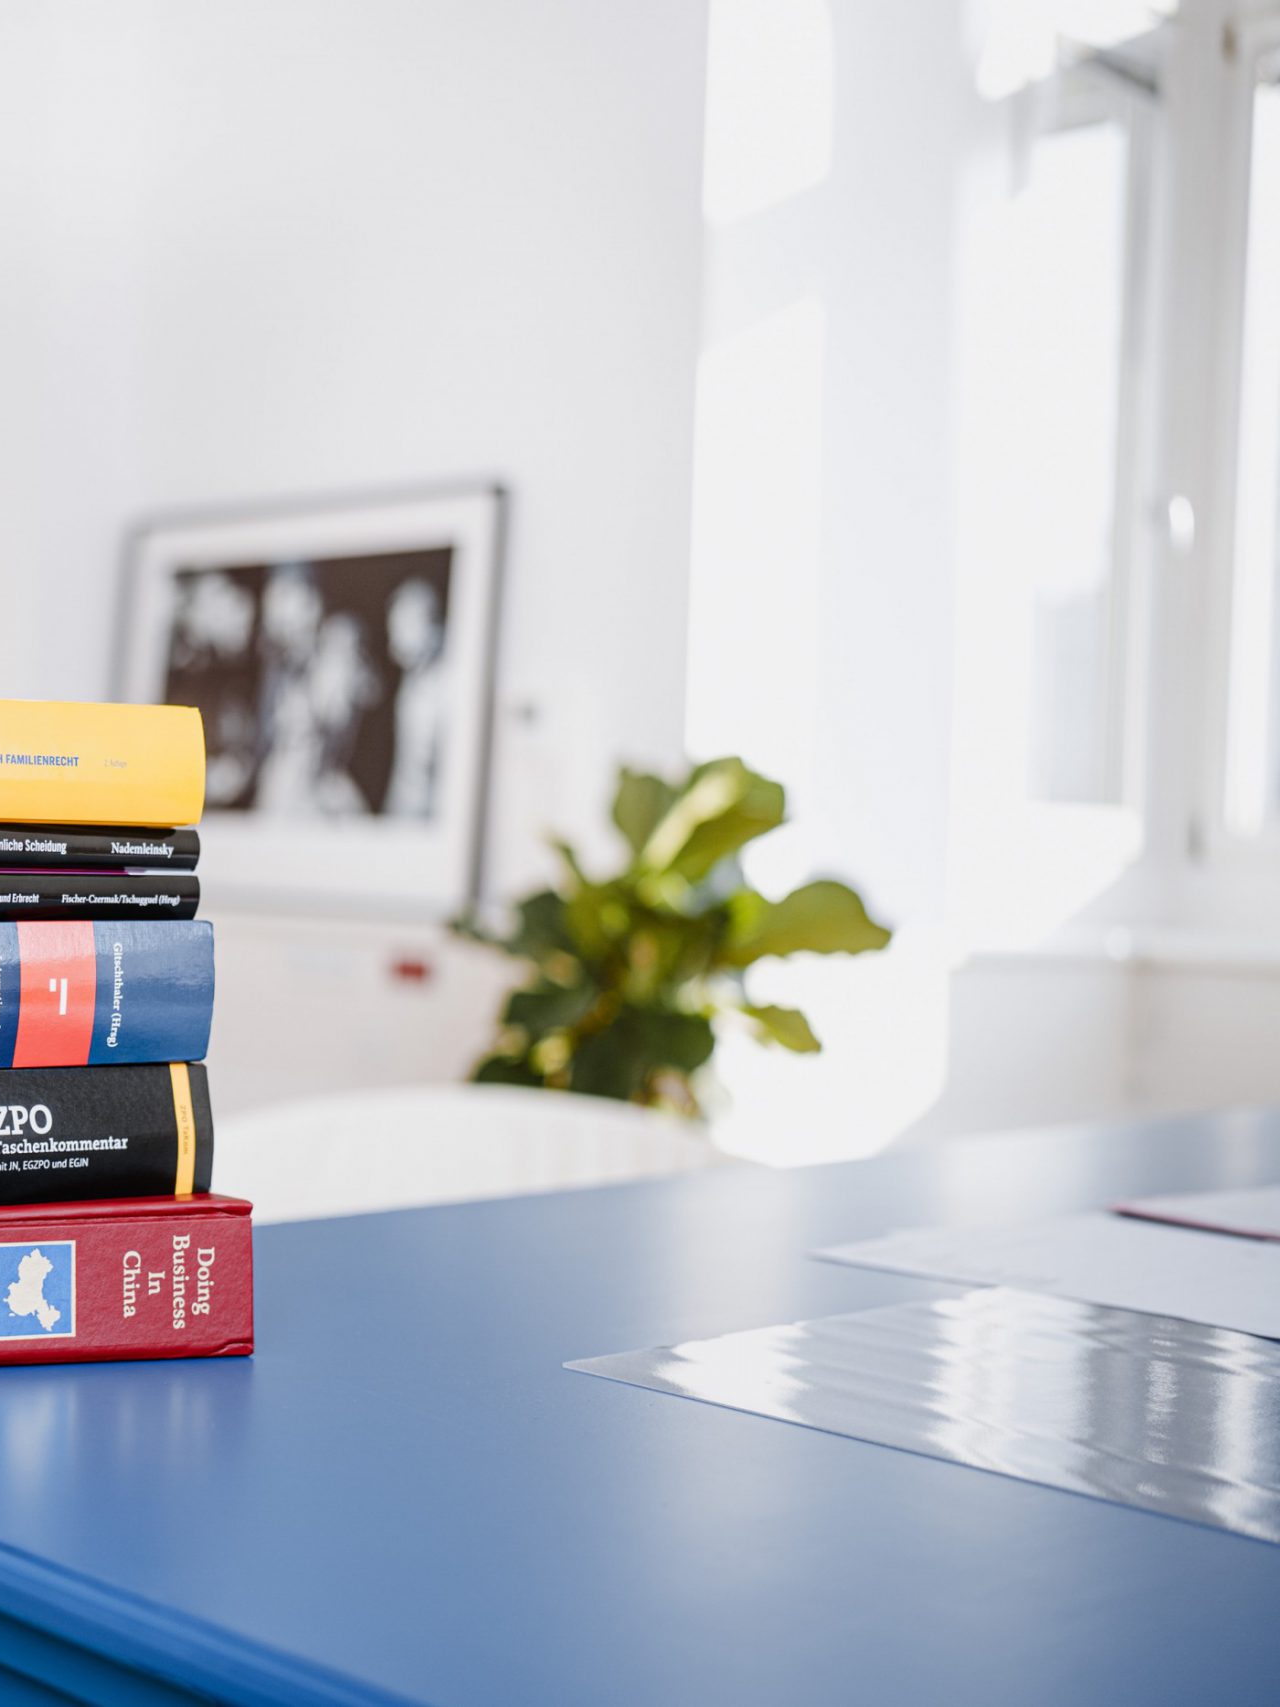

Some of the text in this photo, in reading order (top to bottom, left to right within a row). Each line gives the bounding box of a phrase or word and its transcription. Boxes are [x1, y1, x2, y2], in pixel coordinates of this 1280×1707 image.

[5, 754, 79, 767] FAMILIENRECHT
[24, 840, 67, 855] Scheidung
[111, 842, 174, 858] Nademleinsky
[0, 893, 12, 903] und
[12, 893, 40, 903] Erbrecht
[106, 942, 124, 1048] Gitschthaler (Hrsg)
[8, 1161, 21, 1173] JN,
[22, 1159, 51, 1170] EGZPO
[51, 1158, 67, 1169] und
[123, 1250, 141, 1318] China
[148, 1271, 166, 1295] In
[173, 1234, 190, 1329] Business
[191, 1246, 215, 1315] Doing
